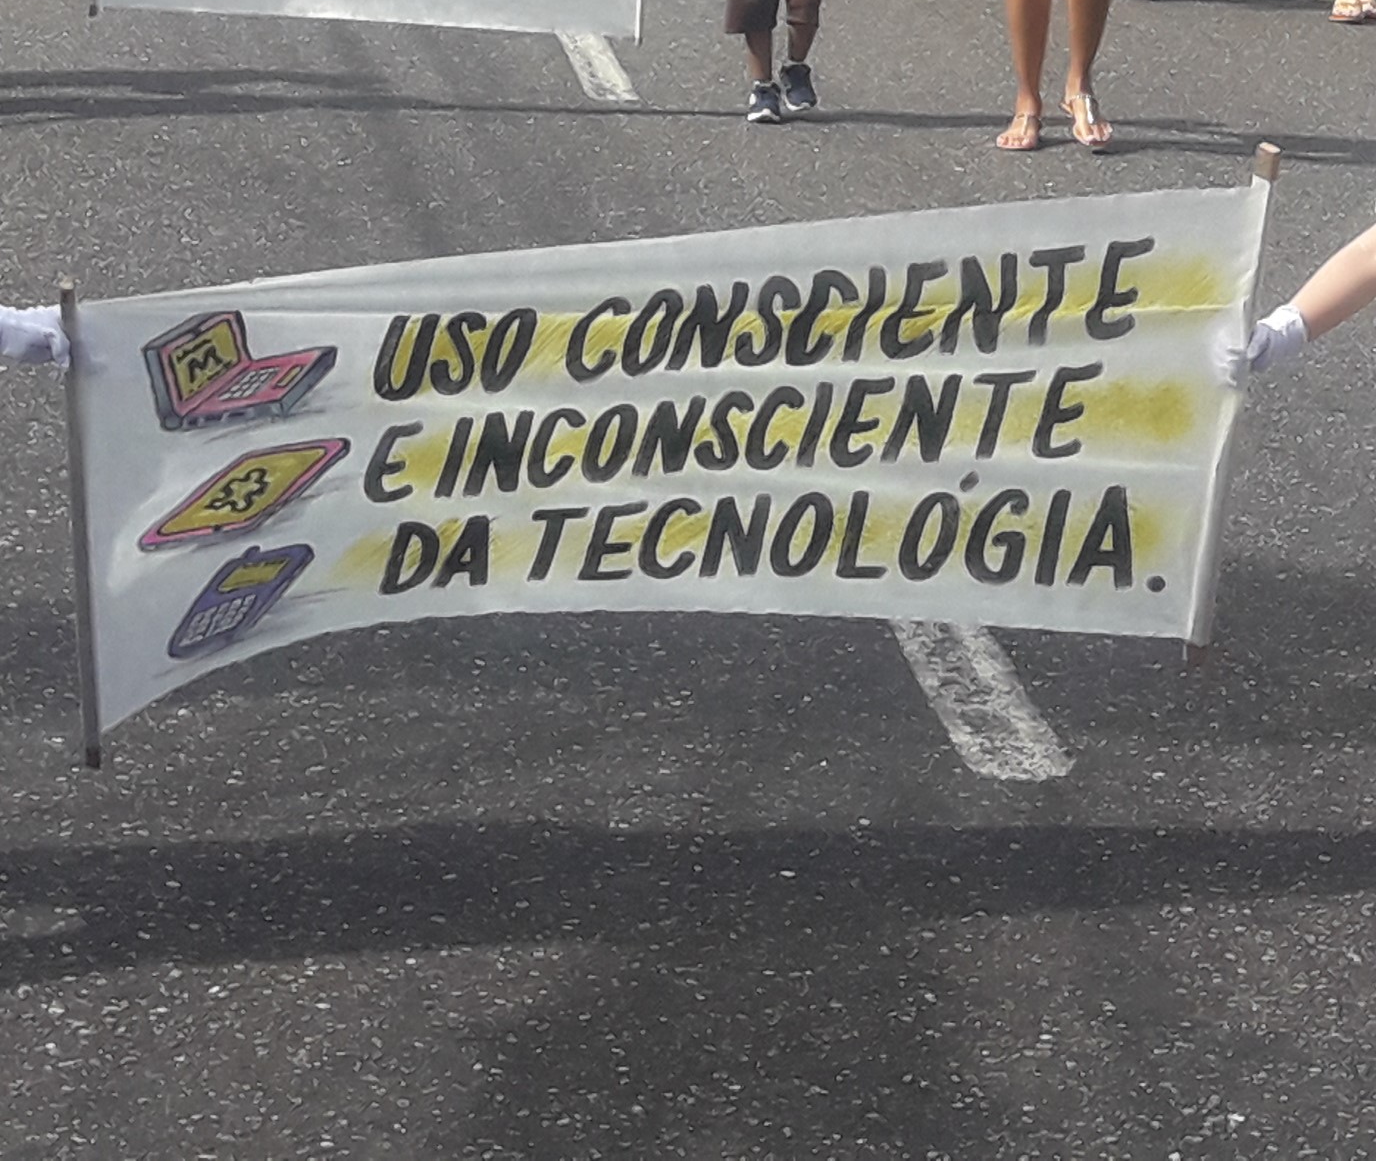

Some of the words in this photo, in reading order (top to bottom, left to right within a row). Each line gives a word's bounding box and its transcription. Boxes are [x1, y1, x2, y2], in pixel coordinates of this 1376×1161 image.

[373, 307, 538, 401] USO
[565, 236, 1155, 384] CONSCIENTE
[363, 421, 423, 503] E
[434, 362, 1104, 498] INCONSCIENTE
[378, 514, 492, 596] DA
